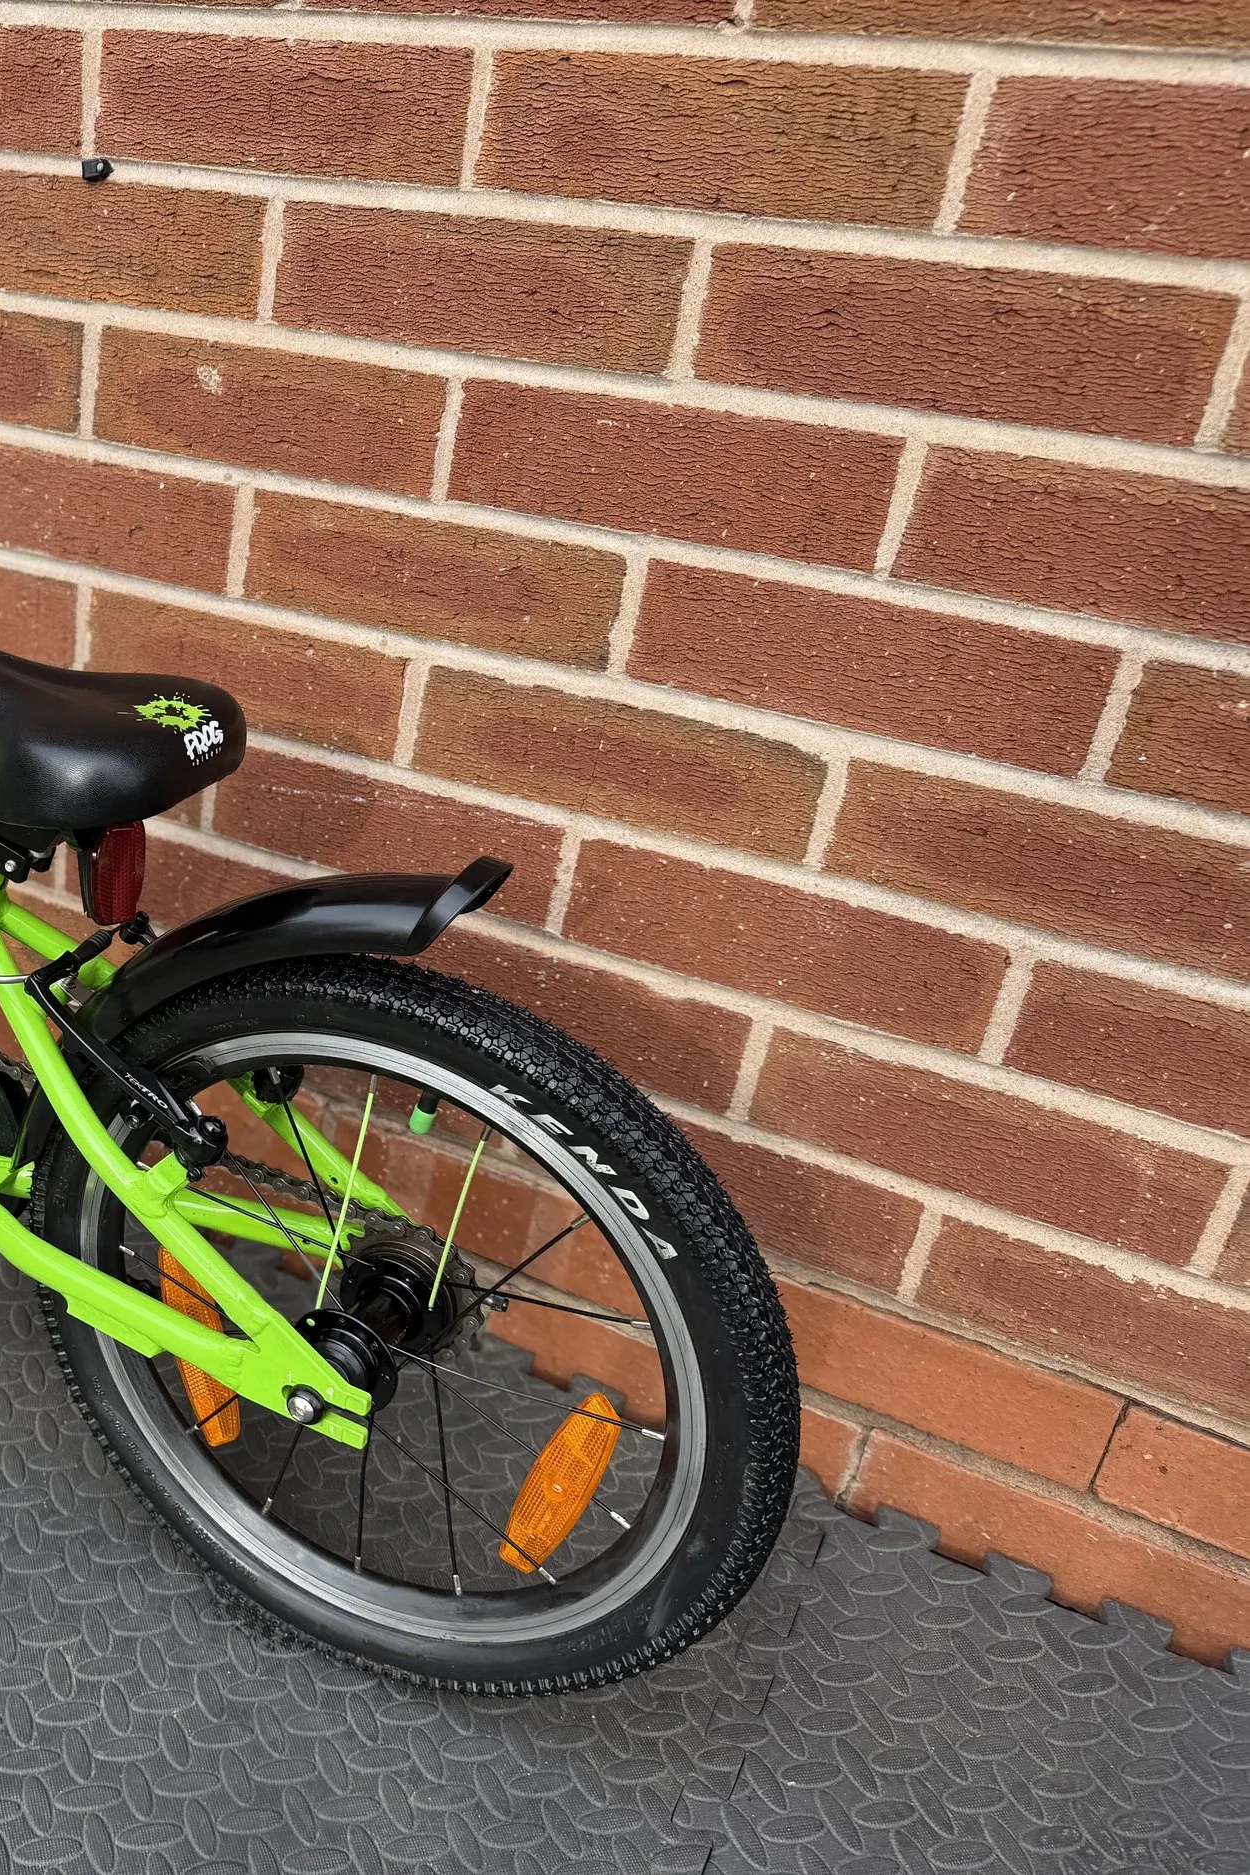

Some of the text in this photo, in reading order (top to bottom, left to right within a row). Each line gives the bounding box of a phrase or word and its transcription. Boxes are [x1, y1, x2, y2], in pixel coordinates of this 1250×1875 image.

[183, 720, 224, 760] FROG
[125, 1072, 168, 1109] TEKTRO
[489, 1083, 679, 1260] KENDA
